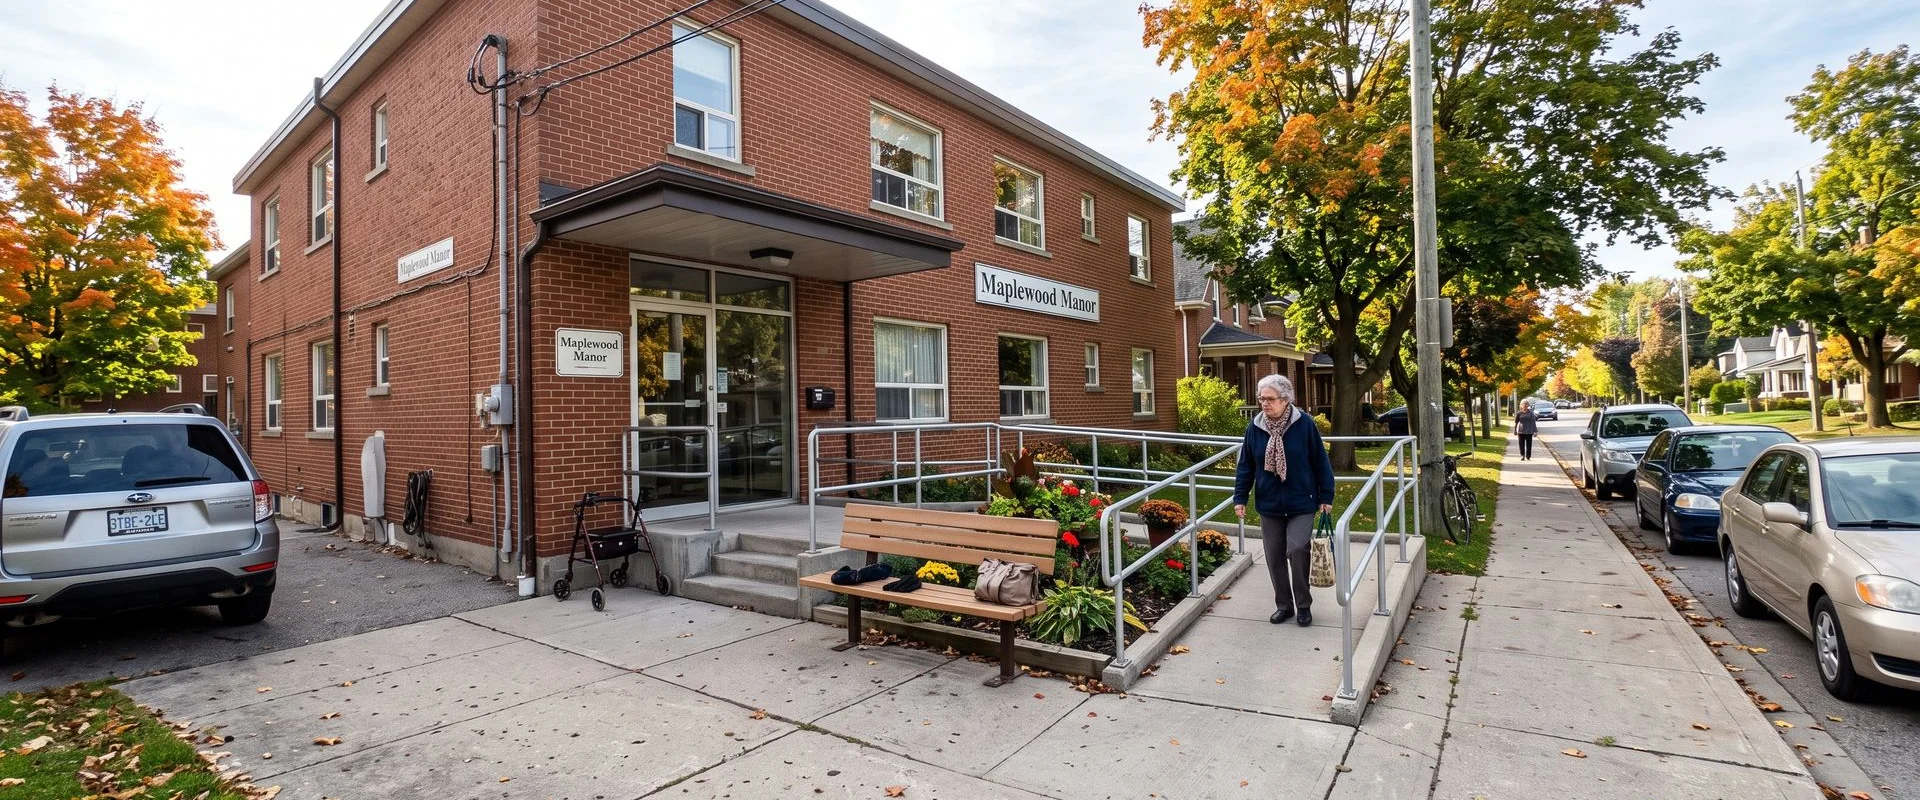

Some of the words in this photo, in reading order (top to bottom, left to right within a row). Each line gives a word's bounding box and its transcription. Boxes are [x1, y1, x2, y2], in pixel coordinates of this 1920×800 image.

[430, 249, 451, 265] Manor
[981, 272, 1057, 306] Maplewood
[1061, 289, 1096, 313] Manor
[561, 337, 618, 350] Maplewood
[573, 351, 607, 362] Manor
